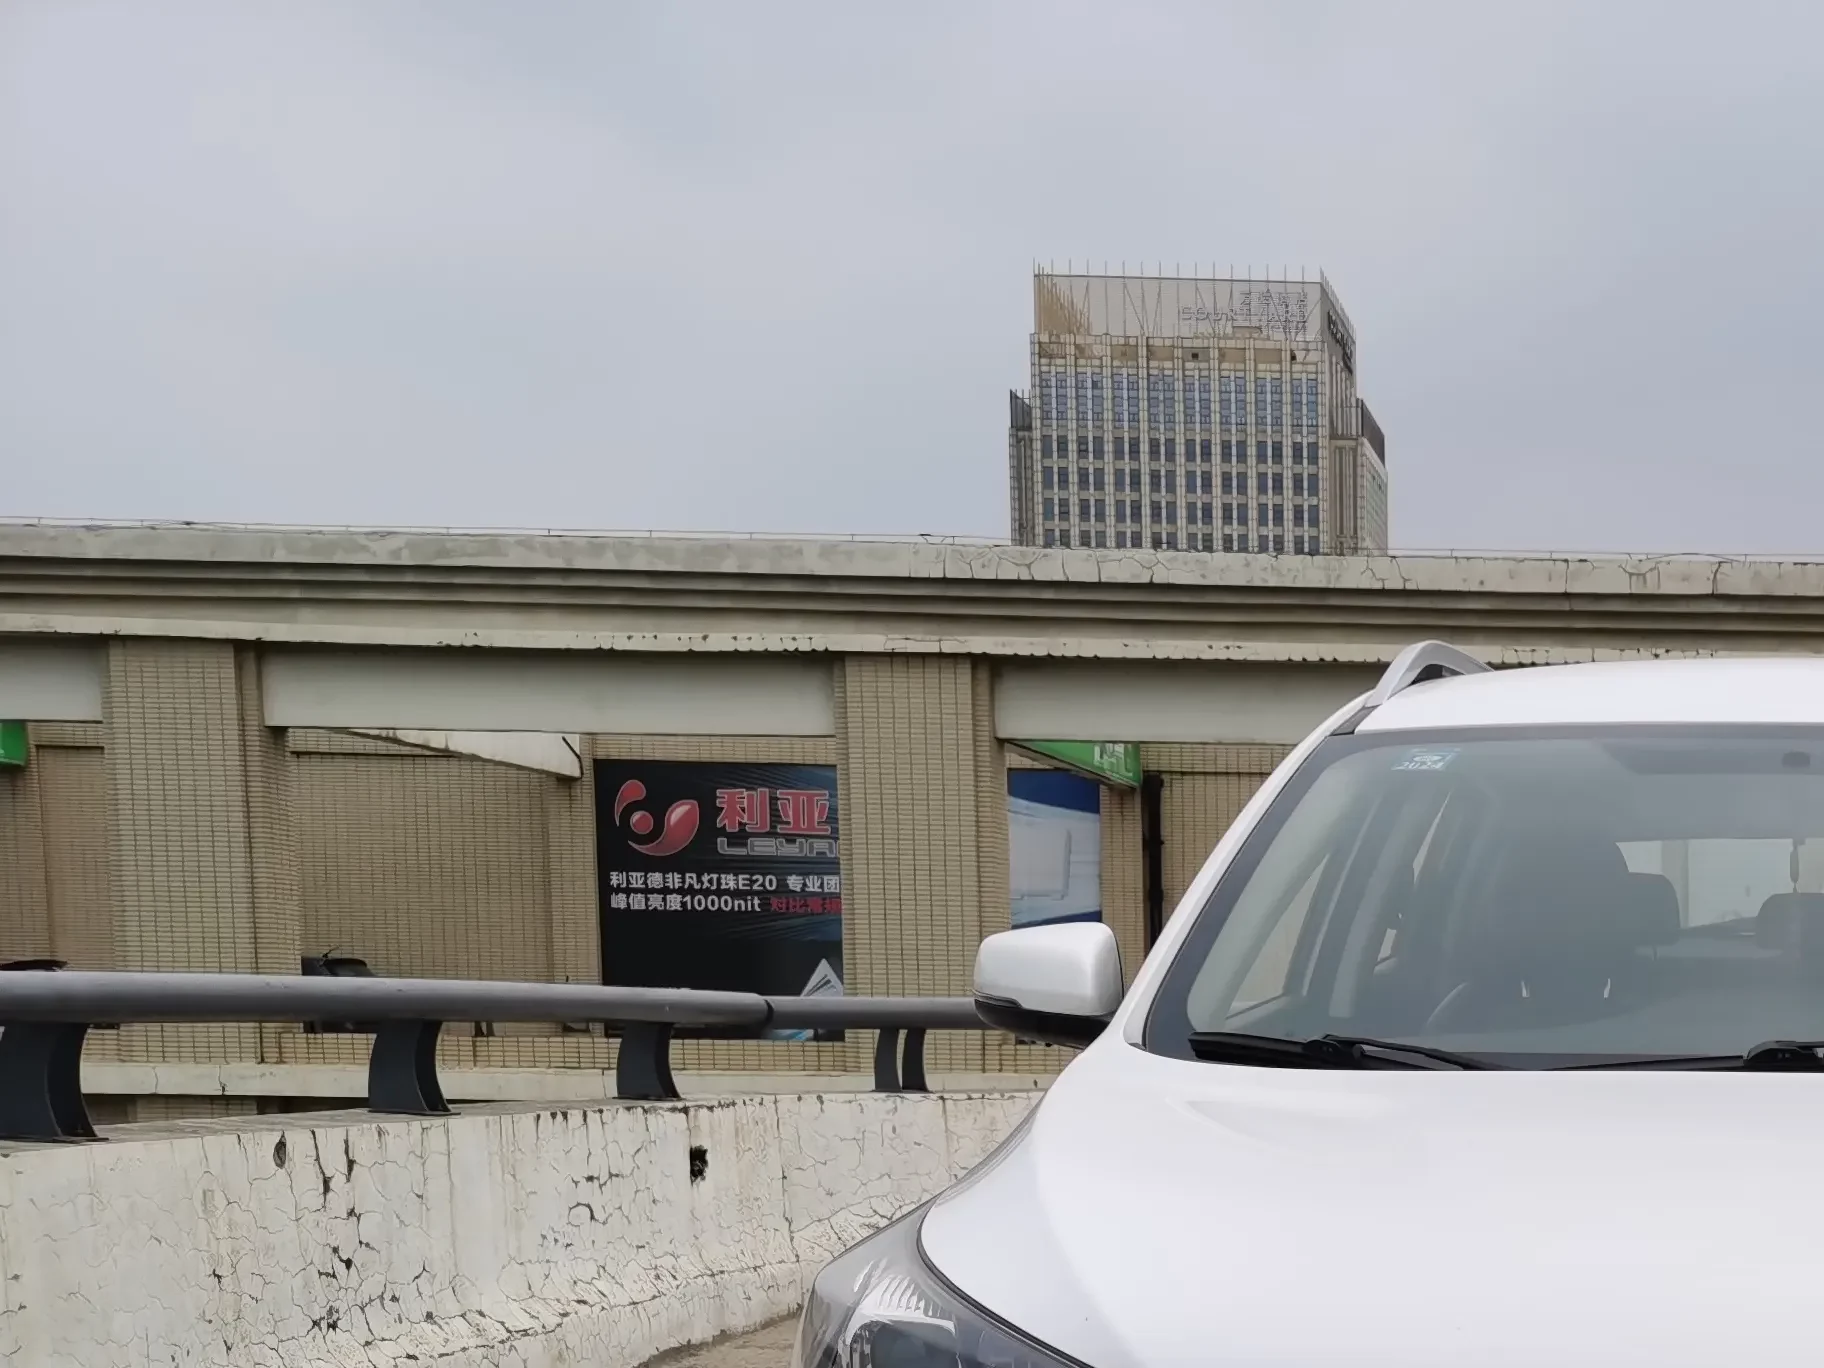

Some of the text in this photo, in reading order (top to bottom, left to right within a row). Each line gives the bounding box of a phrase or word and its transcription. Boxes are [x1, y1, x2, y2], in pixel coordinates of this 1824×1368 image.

[716, 788, 832, 834] 利亚
[717, 838, 839, 857] LEYA
[611, 894, 762, 912] 峰值亮度1000nit
